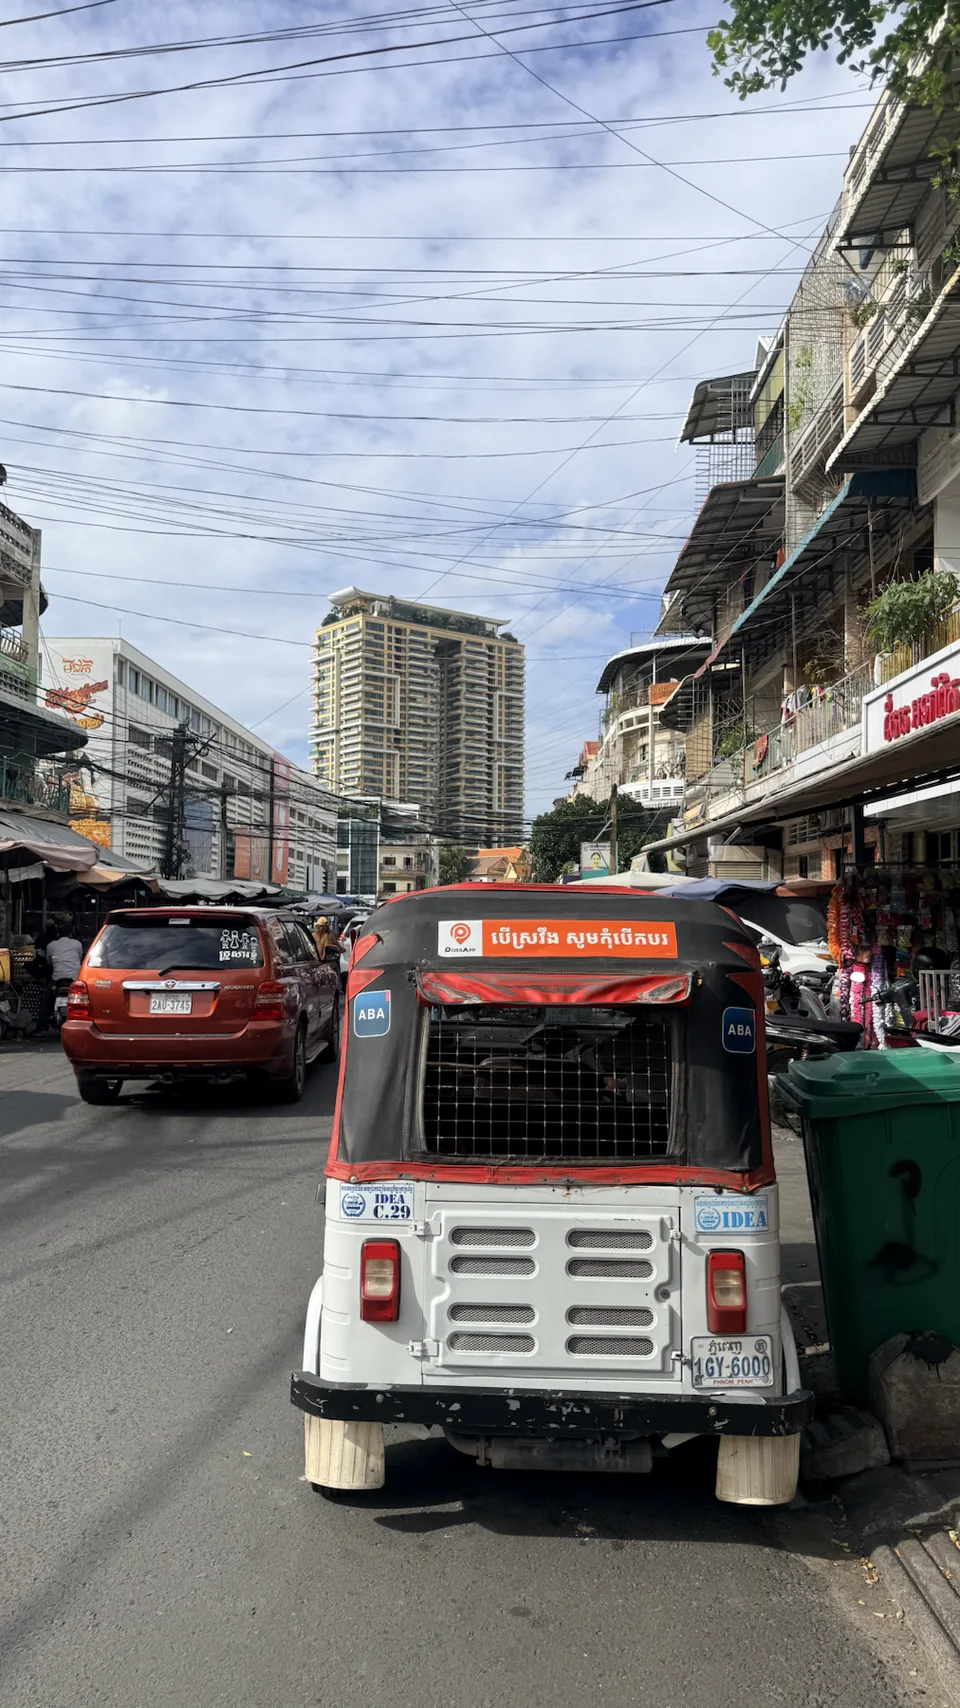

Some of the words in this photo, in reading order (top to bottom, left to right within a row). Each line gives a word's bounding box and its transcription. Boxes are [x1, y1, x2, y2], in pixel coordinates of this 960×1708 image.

[491, 926, 560, 949] បើស្រវឹង
[566, 927, 668, 949] សូមកុំបើកបរ
[152, 999, 190, 1011] 2AU-3745
[358, 1007, 386, 1021] ABA
[727, 1023, 752, 1037] ABA
[375, 1193, 405, 1204] IDEA
[373, 1205, 411, 1219] C.29
[722, 1211, 767, 1229] IDEA
[694, 1355, 770, 1377] 1GY-6000
